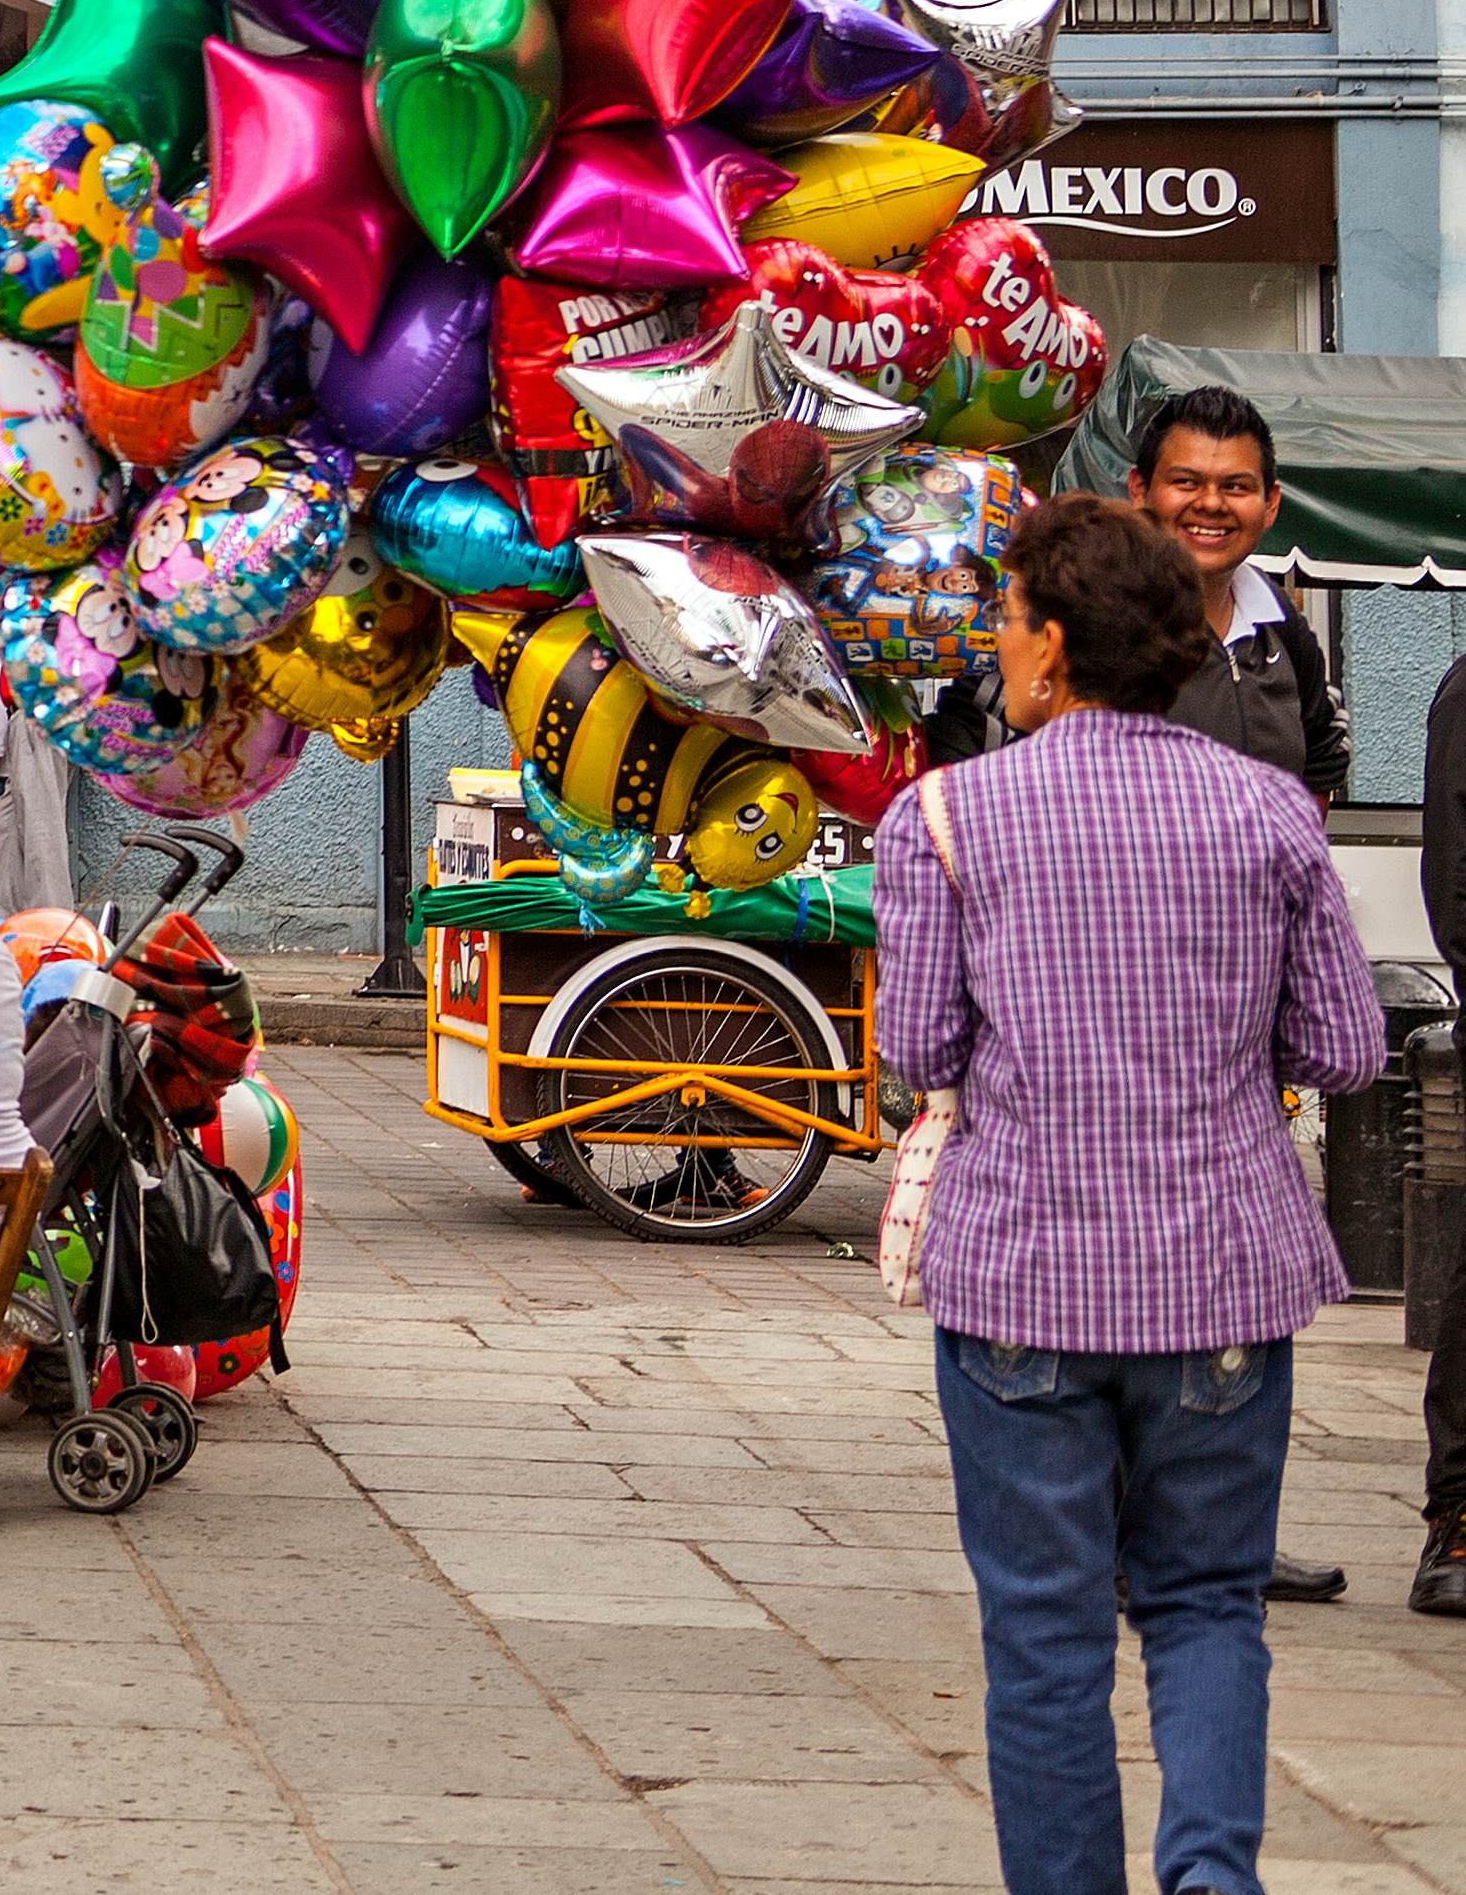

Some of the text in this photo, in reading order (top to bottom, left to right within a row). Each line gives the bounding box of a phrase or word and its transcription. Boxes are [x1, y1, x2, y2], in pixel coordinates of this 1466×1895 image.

[558, 293, 620, 334] POR
[1001, 295, 1089, 369] AMO
[797, 313, 904, 369] AMO
[640, 408, 780, 430] SPIDER-MAN
[691, 407, 759, 419] AMAZING
